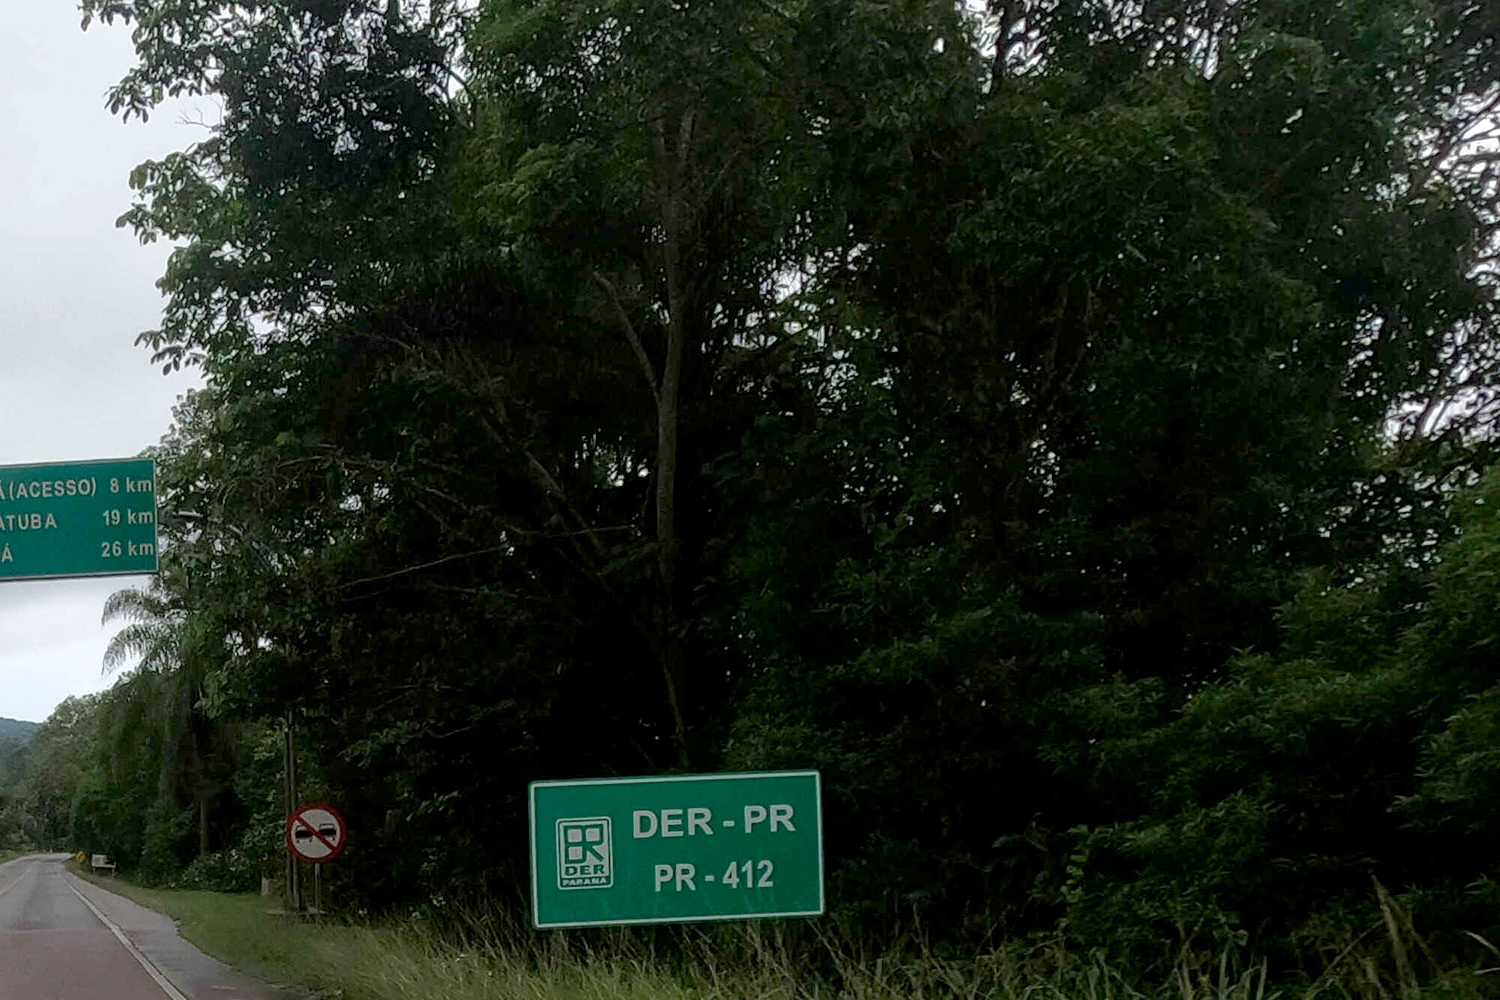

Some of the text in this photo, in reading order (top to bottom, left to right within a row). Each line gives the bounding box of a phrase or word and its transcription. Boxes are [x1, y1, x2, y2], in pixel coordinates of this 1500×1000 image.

[9, 477, 97, 501] (ACESSO)
[110, 477, 119, 493] 8
[126, 477, 152, 492] km
[103, 509, 120, 526] 19
[128, 508, 153, 524] km
[102, 541, 121, 558] 26
[129, 541, 154, 556] km
[632, 807, 713, 839] DER
[744, 804, 796, 833] PR
[565, 864, 605, 876] DER
[655, 863, 696, 892] PR
[723, 860, 774, 889] 412
